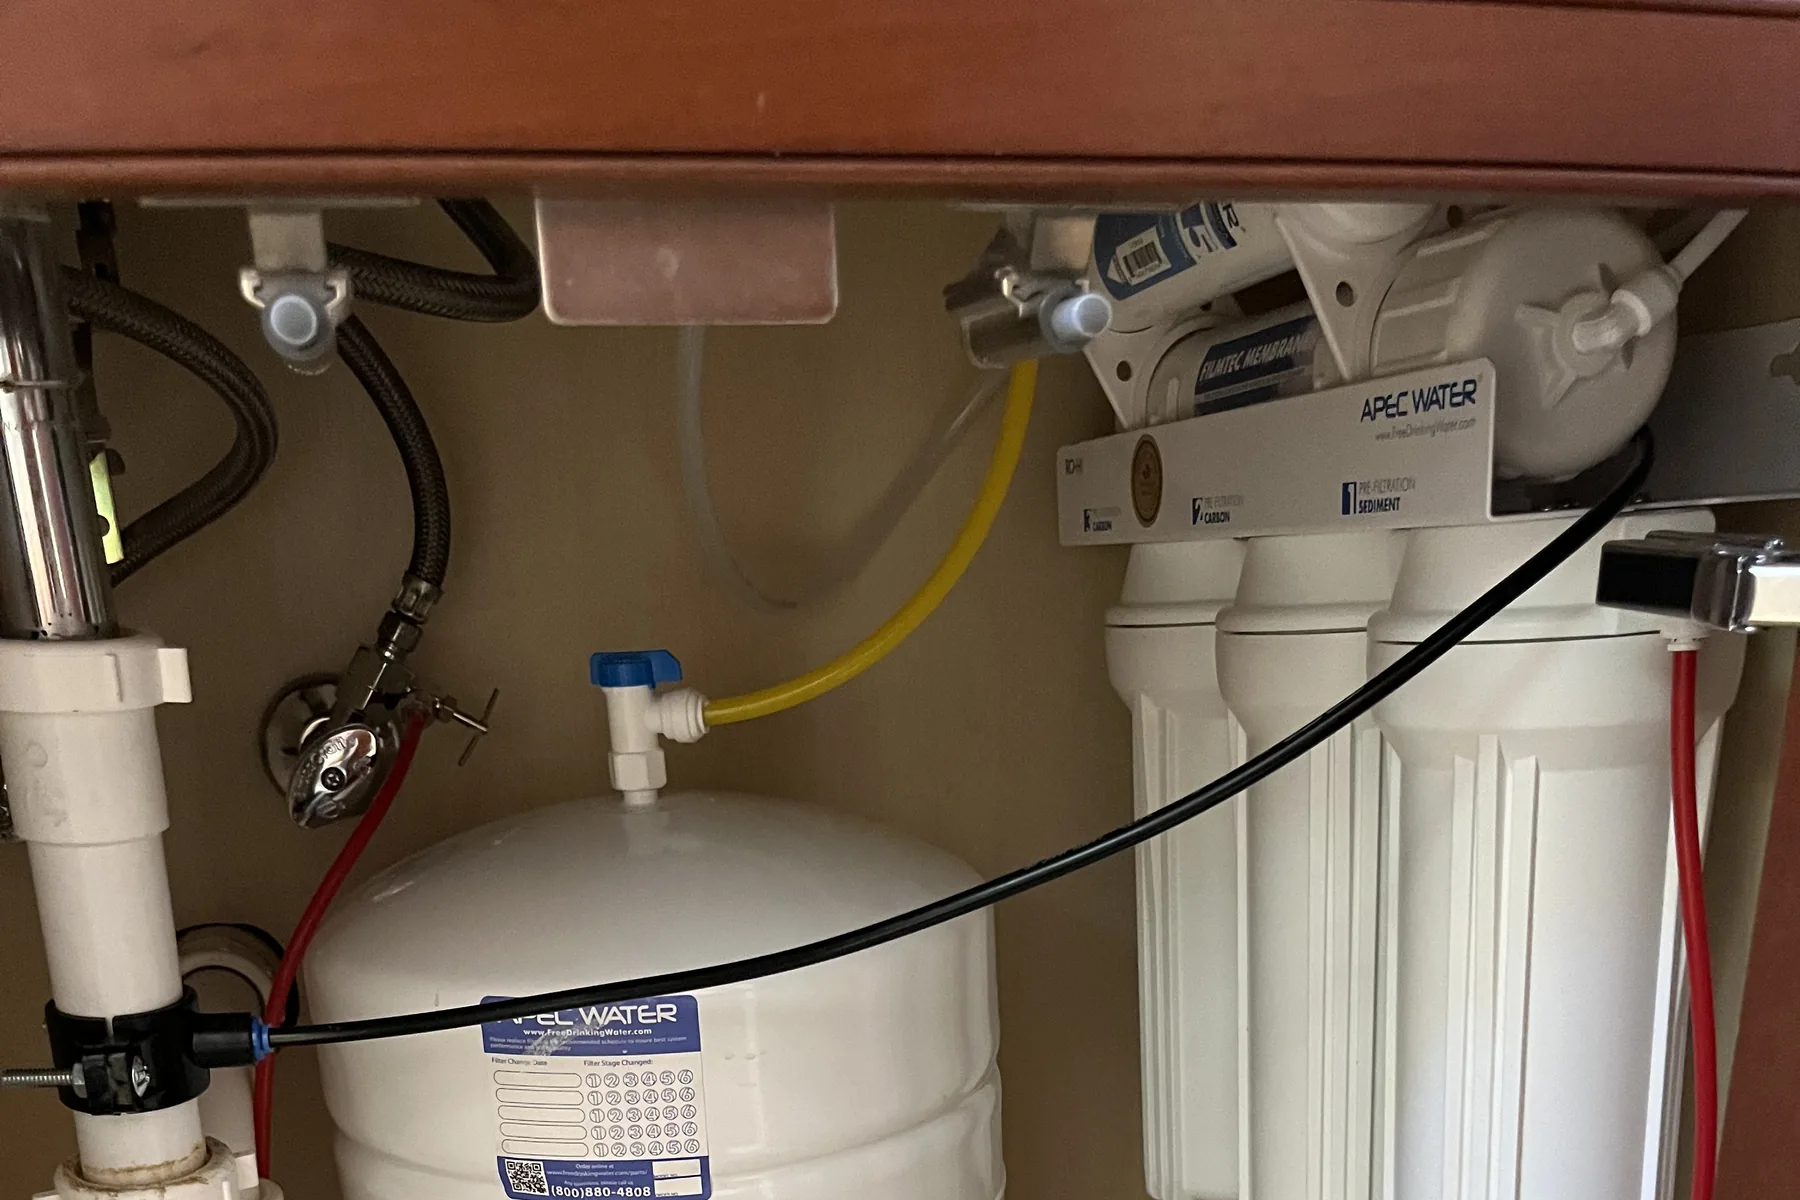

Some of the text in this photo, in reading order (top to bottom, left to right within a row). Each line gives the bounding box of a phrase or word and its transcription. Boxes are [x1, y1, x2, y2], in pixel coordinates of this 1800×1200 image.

[1199, 350, 1246, 382] FILMTEC
[1360, 379, 1477, 422] APEC WATER
[1359, 497, 1400, 513] SEDIMENT
[1205, 511, 1230, 524] CARBON
[579, 1003, 677, 1025] WATER
[523, 1026, 652, 1038] www.FreeDrinkingWater.com
[601, 1060, 620, 1068] Stage
[551, 1185, 651, 1198] (800)880-4808
